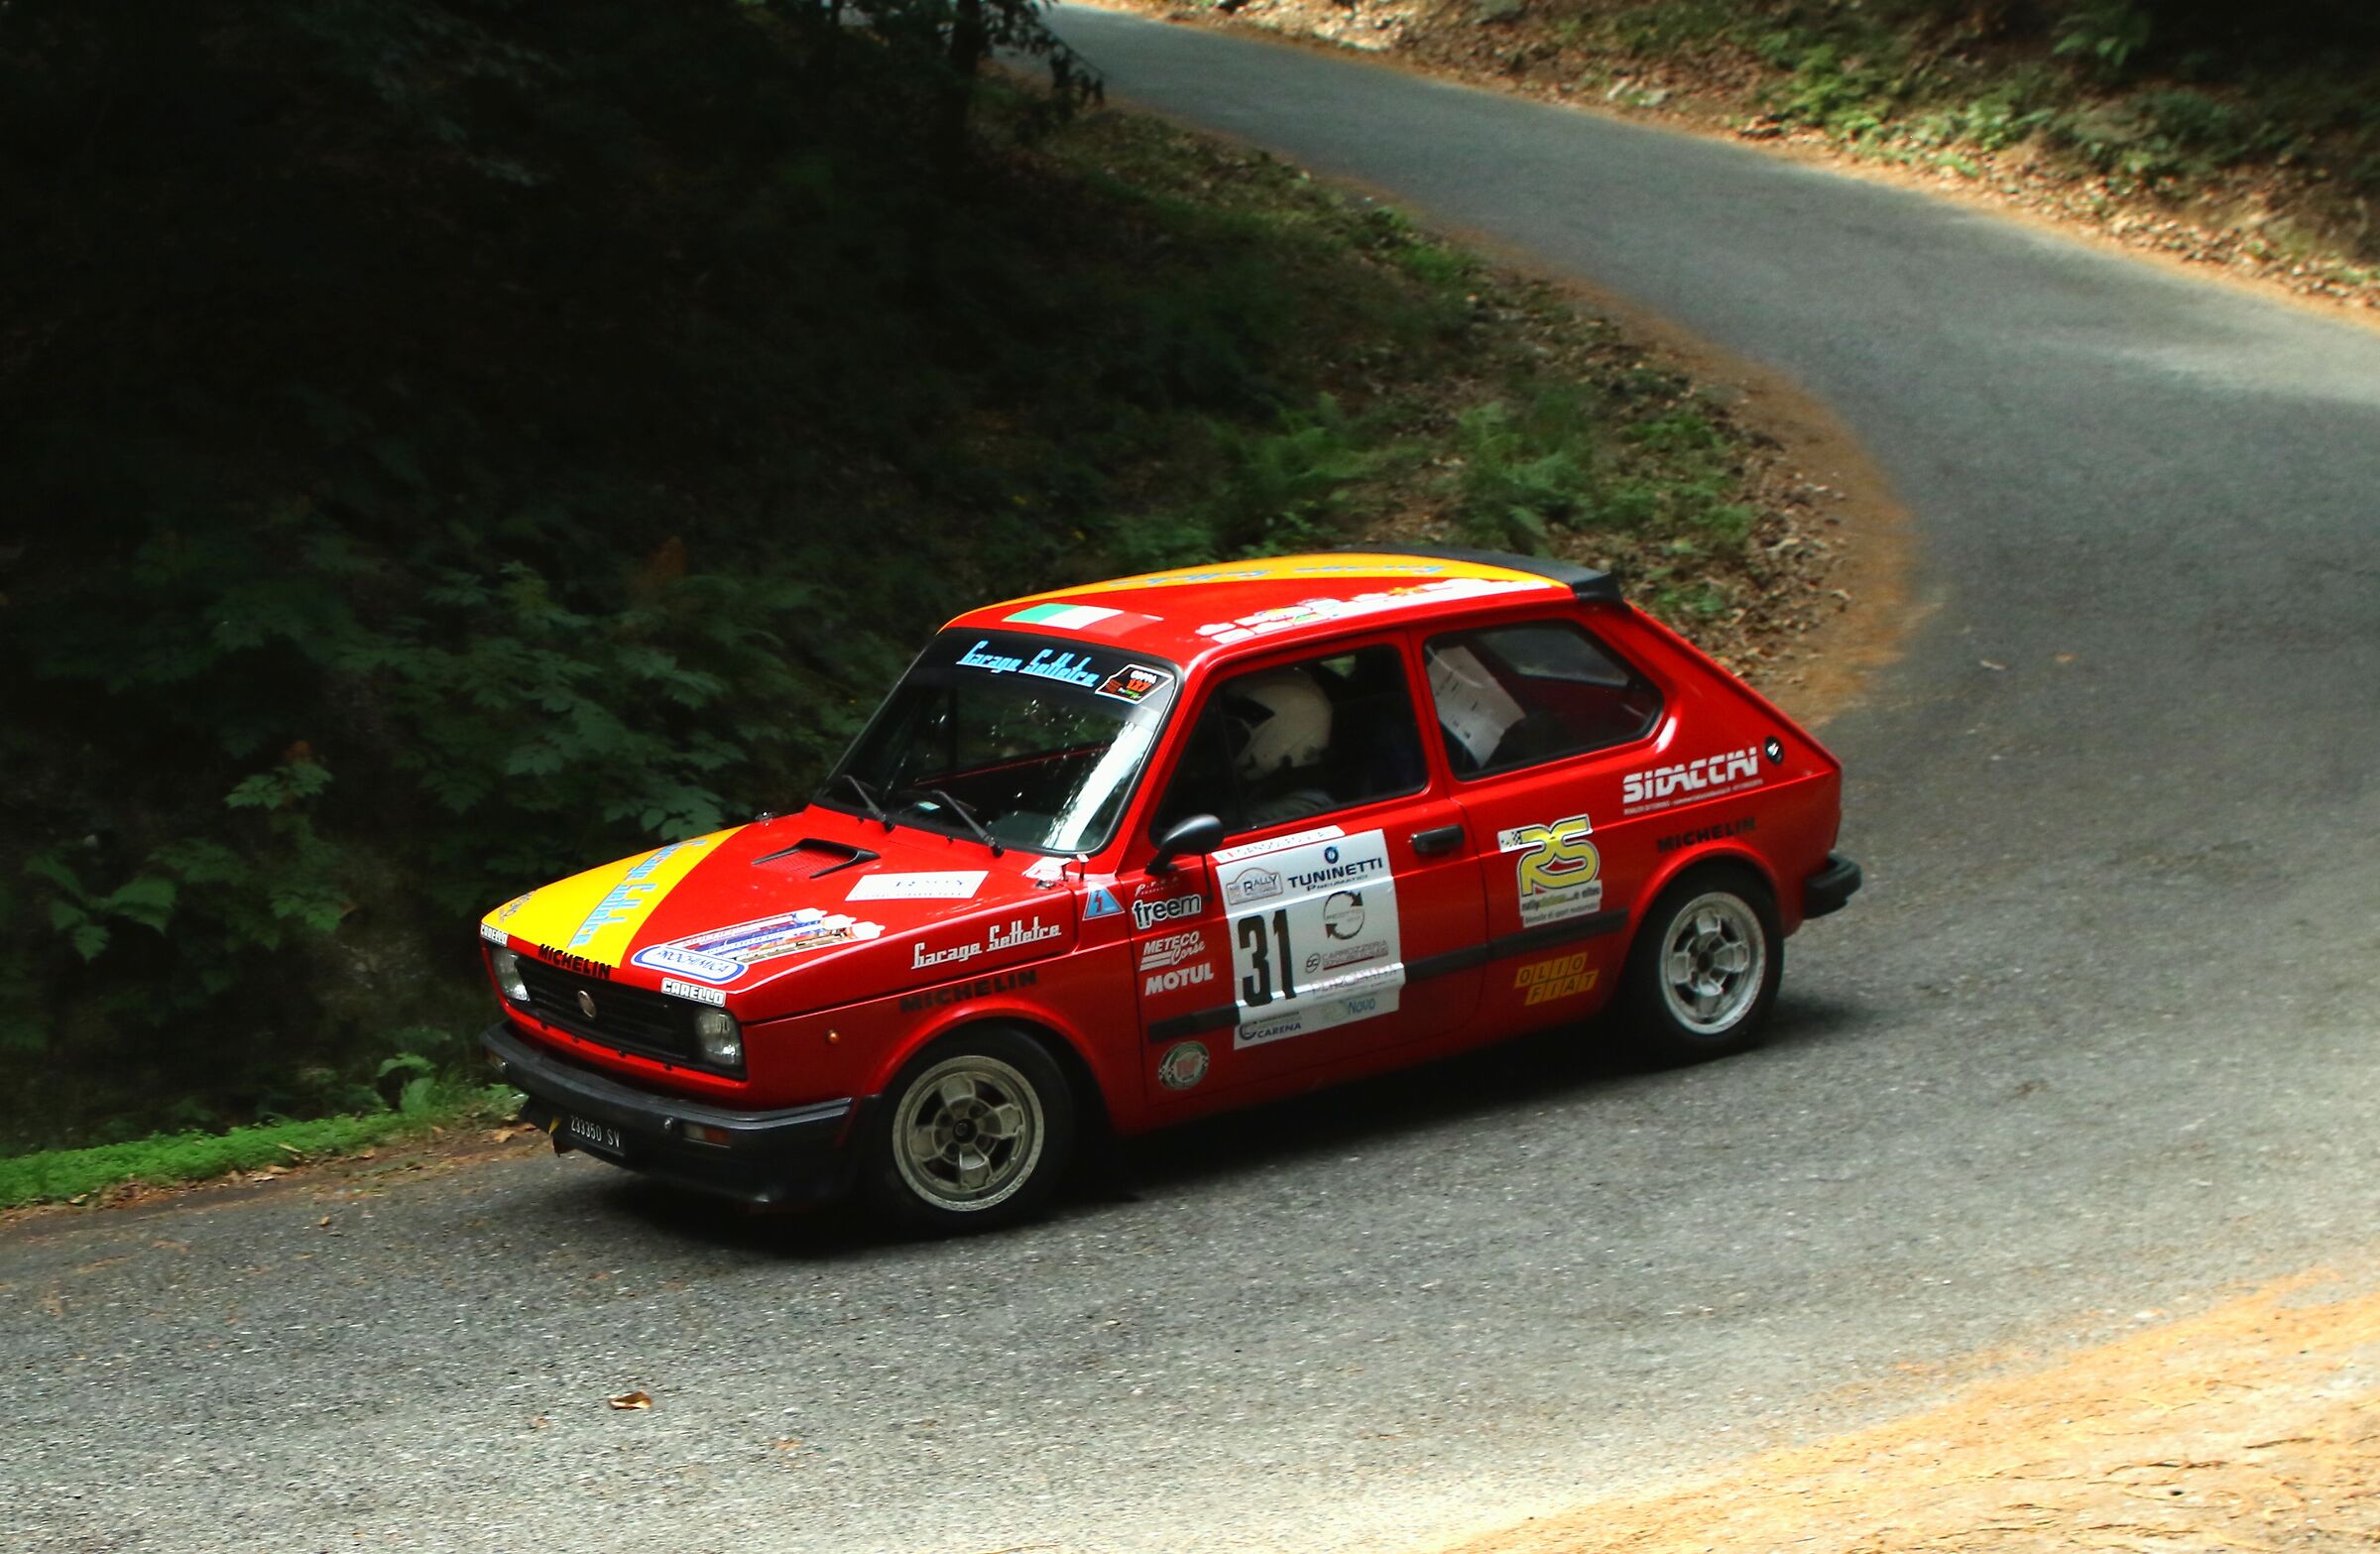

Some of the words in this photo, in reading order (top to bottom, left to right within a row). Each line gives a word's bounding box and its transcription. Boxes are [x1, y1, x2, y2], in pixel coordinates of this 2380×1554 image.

[956, 640, 1022, 673] Garage
[1656, 817, 1756, 854] MICHELIN
[1243, 874, 1278, 894] RALLY
[1288, 857, 1383, 889] TUNINETTI
[1133, 895, 1201, 928] freem
[911, 942, 983, 969] Garage
[1143, 930, 1201, 956] METECO
[1170, 941, 1206, 966] Corse
[1237, 908, 1297, 1008] 31
[538, 943, 612, 980] MICHELIN
[1518, 955, 1585, 985] OLIO
[661, 978, 726, 1007] CARELLO
[899, 970, 1037, 1013] MICHELIN
[1144, 962, 1215, 997] MOTUL
[1530, 972, 1597, 1002] FIAT
[1256, 1022, 1302, 1039] CARENA
[606, 1128, 620, 1147] SV
